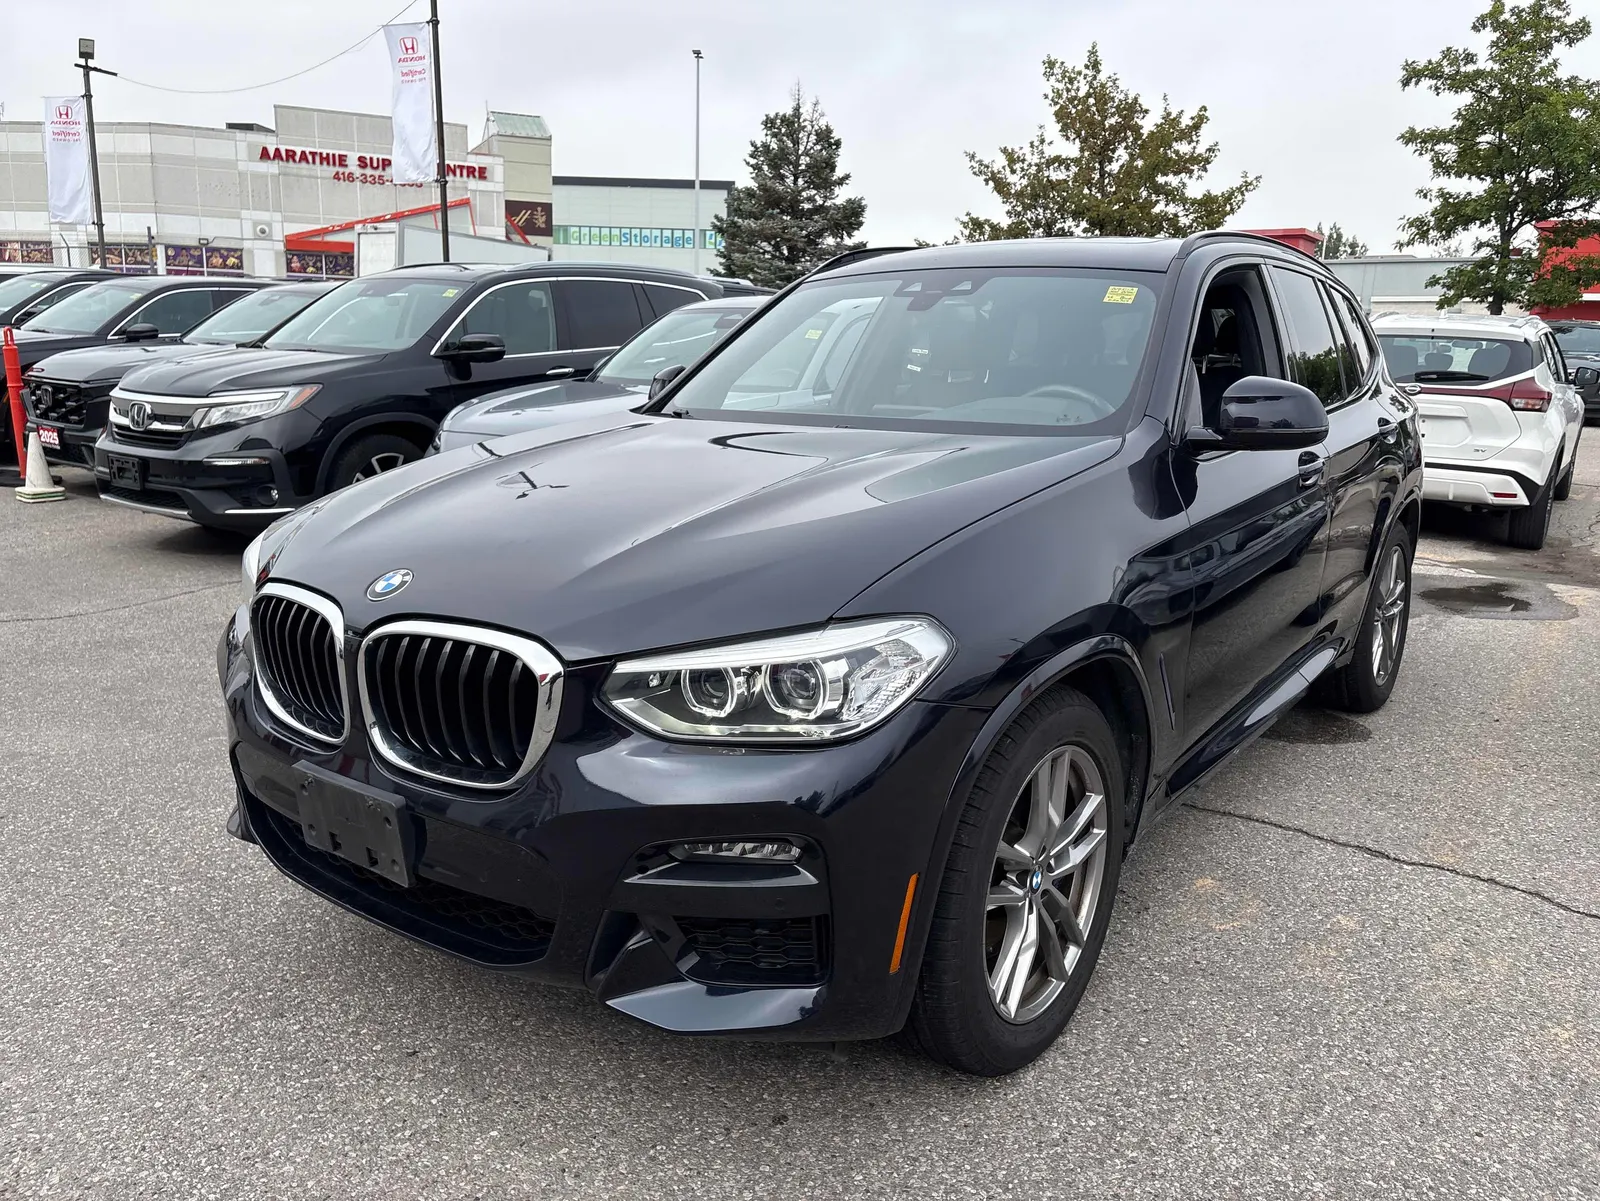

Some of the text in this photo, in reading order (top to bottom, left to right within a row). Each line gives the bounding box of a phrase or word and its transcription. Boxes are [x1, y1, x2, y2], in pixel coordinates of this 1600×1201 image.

[259, 146, 488, 180] AARATHIE SUP NTRE
[332, 171, 424, 188] 416-335-
[40, 429, 59, 445] 2025
